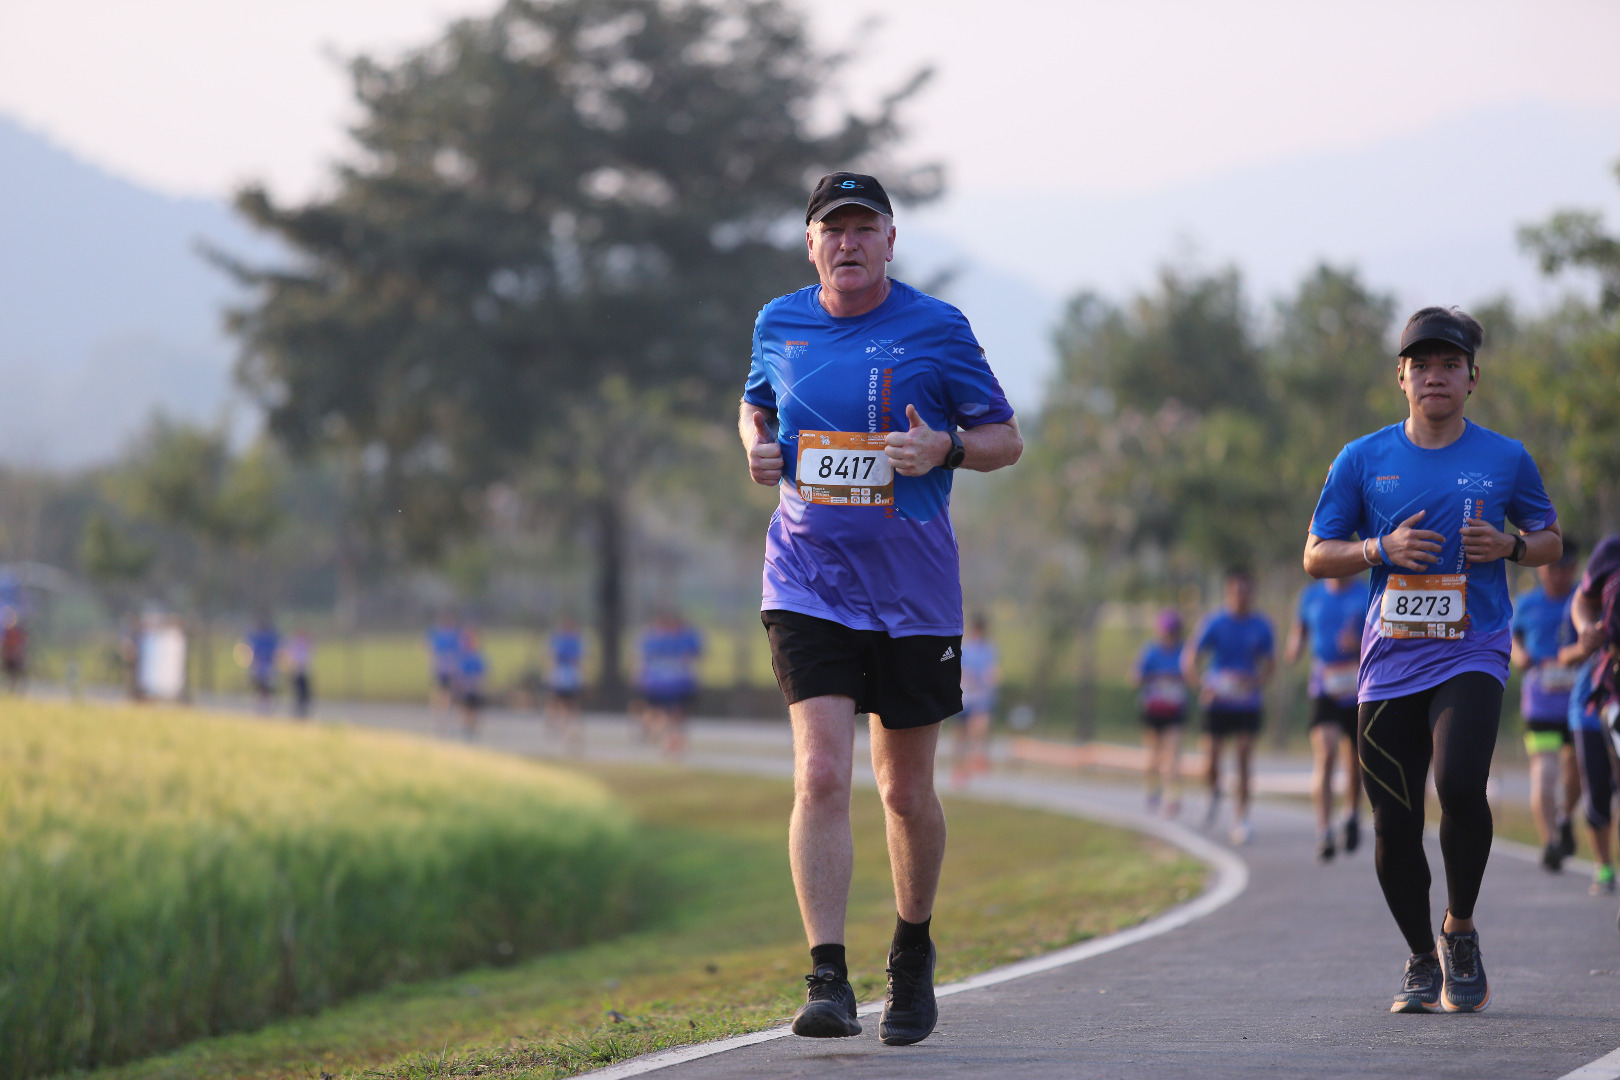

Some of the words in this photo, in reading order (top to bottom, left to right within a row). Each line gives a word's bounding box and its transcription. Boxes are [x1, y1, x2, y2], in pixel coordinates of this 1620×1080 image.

[892, 346, 905, 355] XC
[868, 367, 879, 402] CROSS
[881, 367, 893, 413] SINGHA
[868, 404, 877, 433] COUN
[881, 416, 890, 432] PA
[818, 455, 877, 480] 8417
[1482, 480, 1493, 488] XC
[1395, 595, 1451, 616] 8273
[1448, 627, 1456, 638] 8
